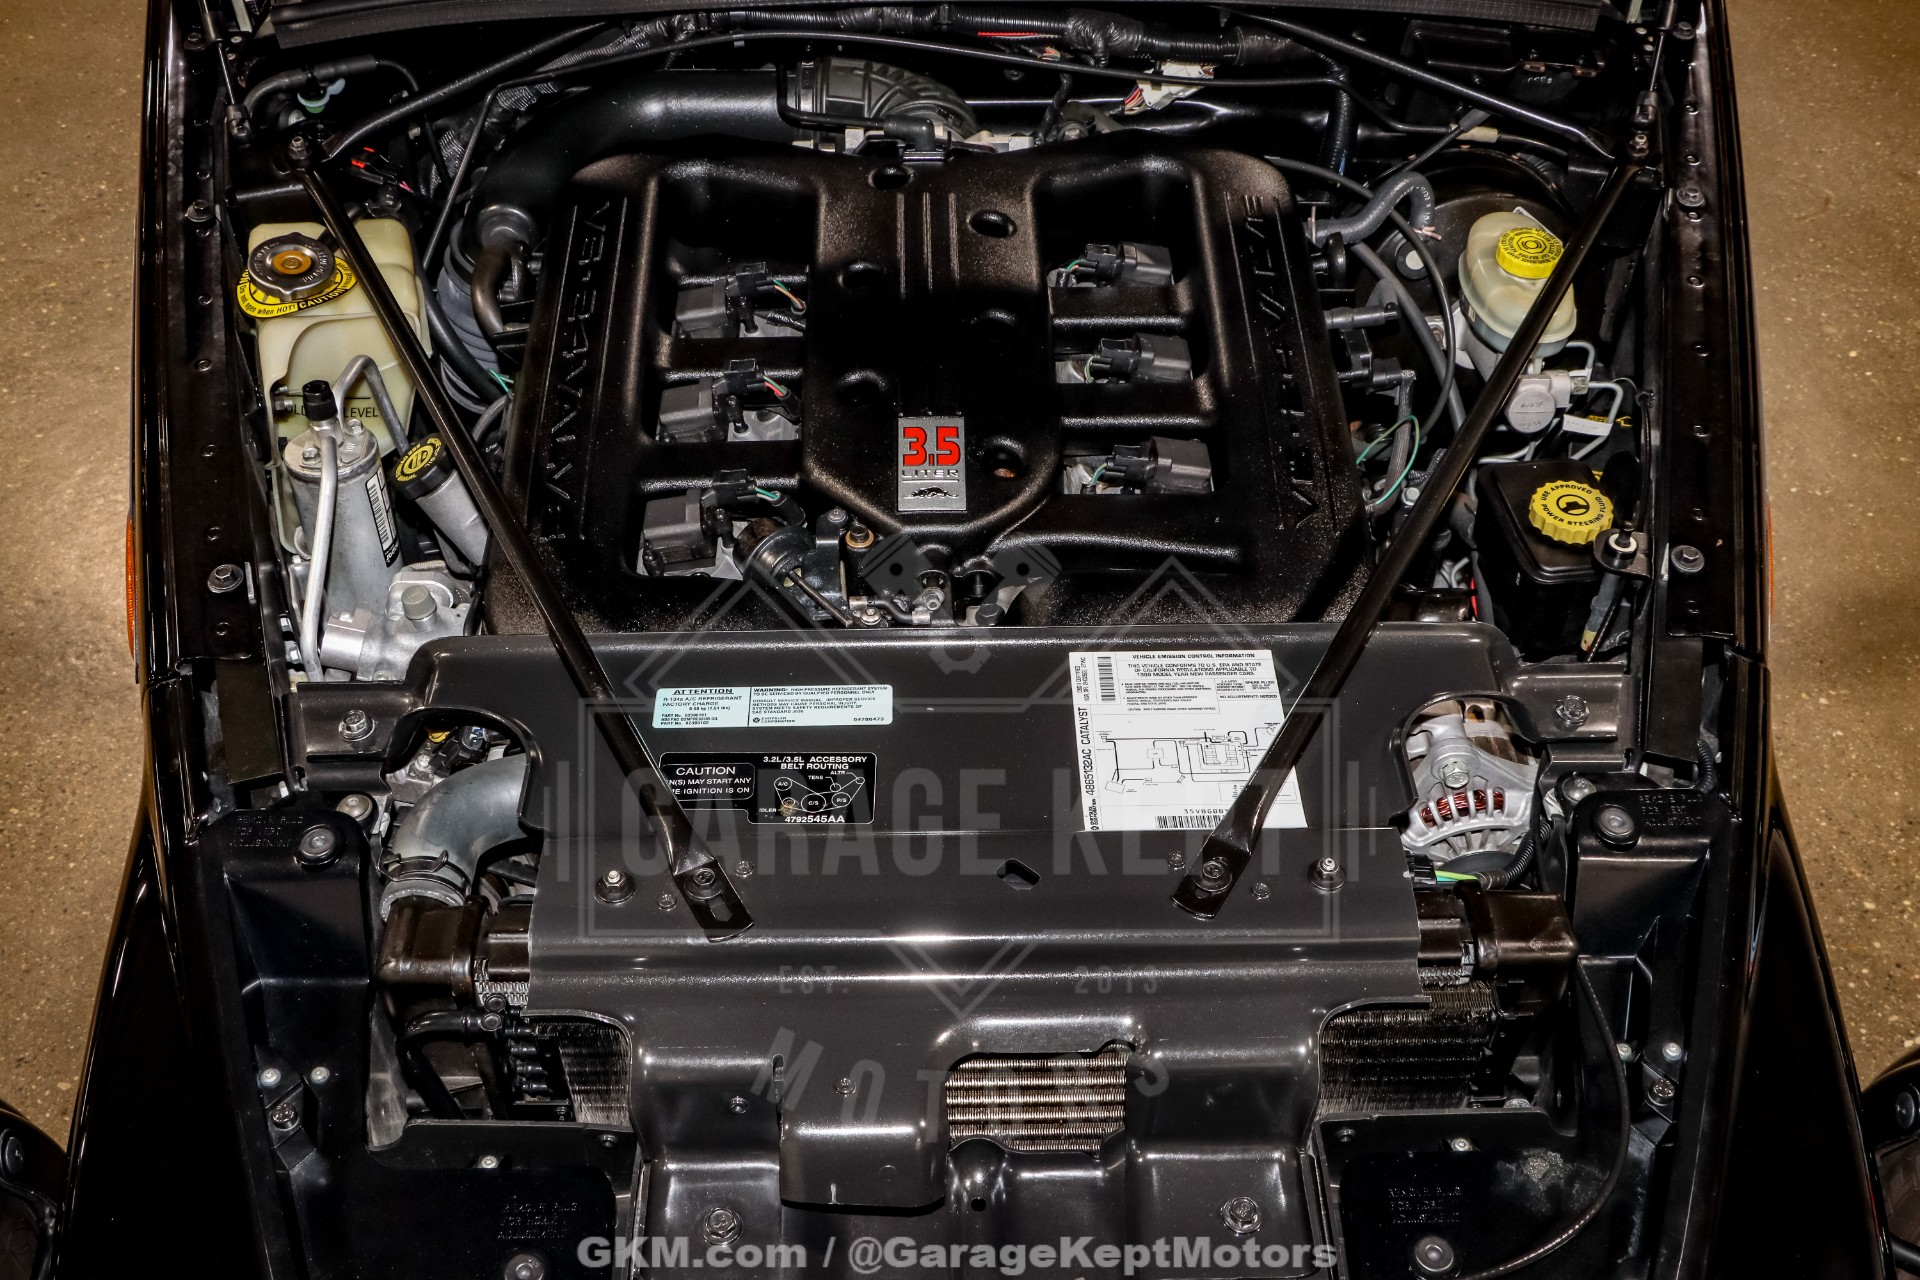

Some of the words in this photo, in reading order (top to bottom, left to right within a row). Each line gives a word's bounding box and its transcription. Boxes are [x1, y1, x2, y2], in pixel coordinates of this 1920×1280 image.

[299, 286, 346, 309] CAUTION
[344, 406, 379, 418] LEVEL
[903, 426, 961, 467] 3.5
[902, 469, 959, 478] LITER
[1541, 490, 1551, 501] USE
[1551, 484, 1592, 494] APPROVED
[1541, 504, 1564, 523] POWER
[1567, 513, 1604, 526] STEERING
[1595, 496, 1606, 513] FLUID
[1078, 707, 1090, 745] CATALYST
[676, 766, 736, 776] CAUTION
[1082, 749, 1095, 795] 4865132AC
[732, 777, 752, 785] ANY
[683, 787, 723, 795] IGNITION
[785, 815, 845, 823] 4792545AA
